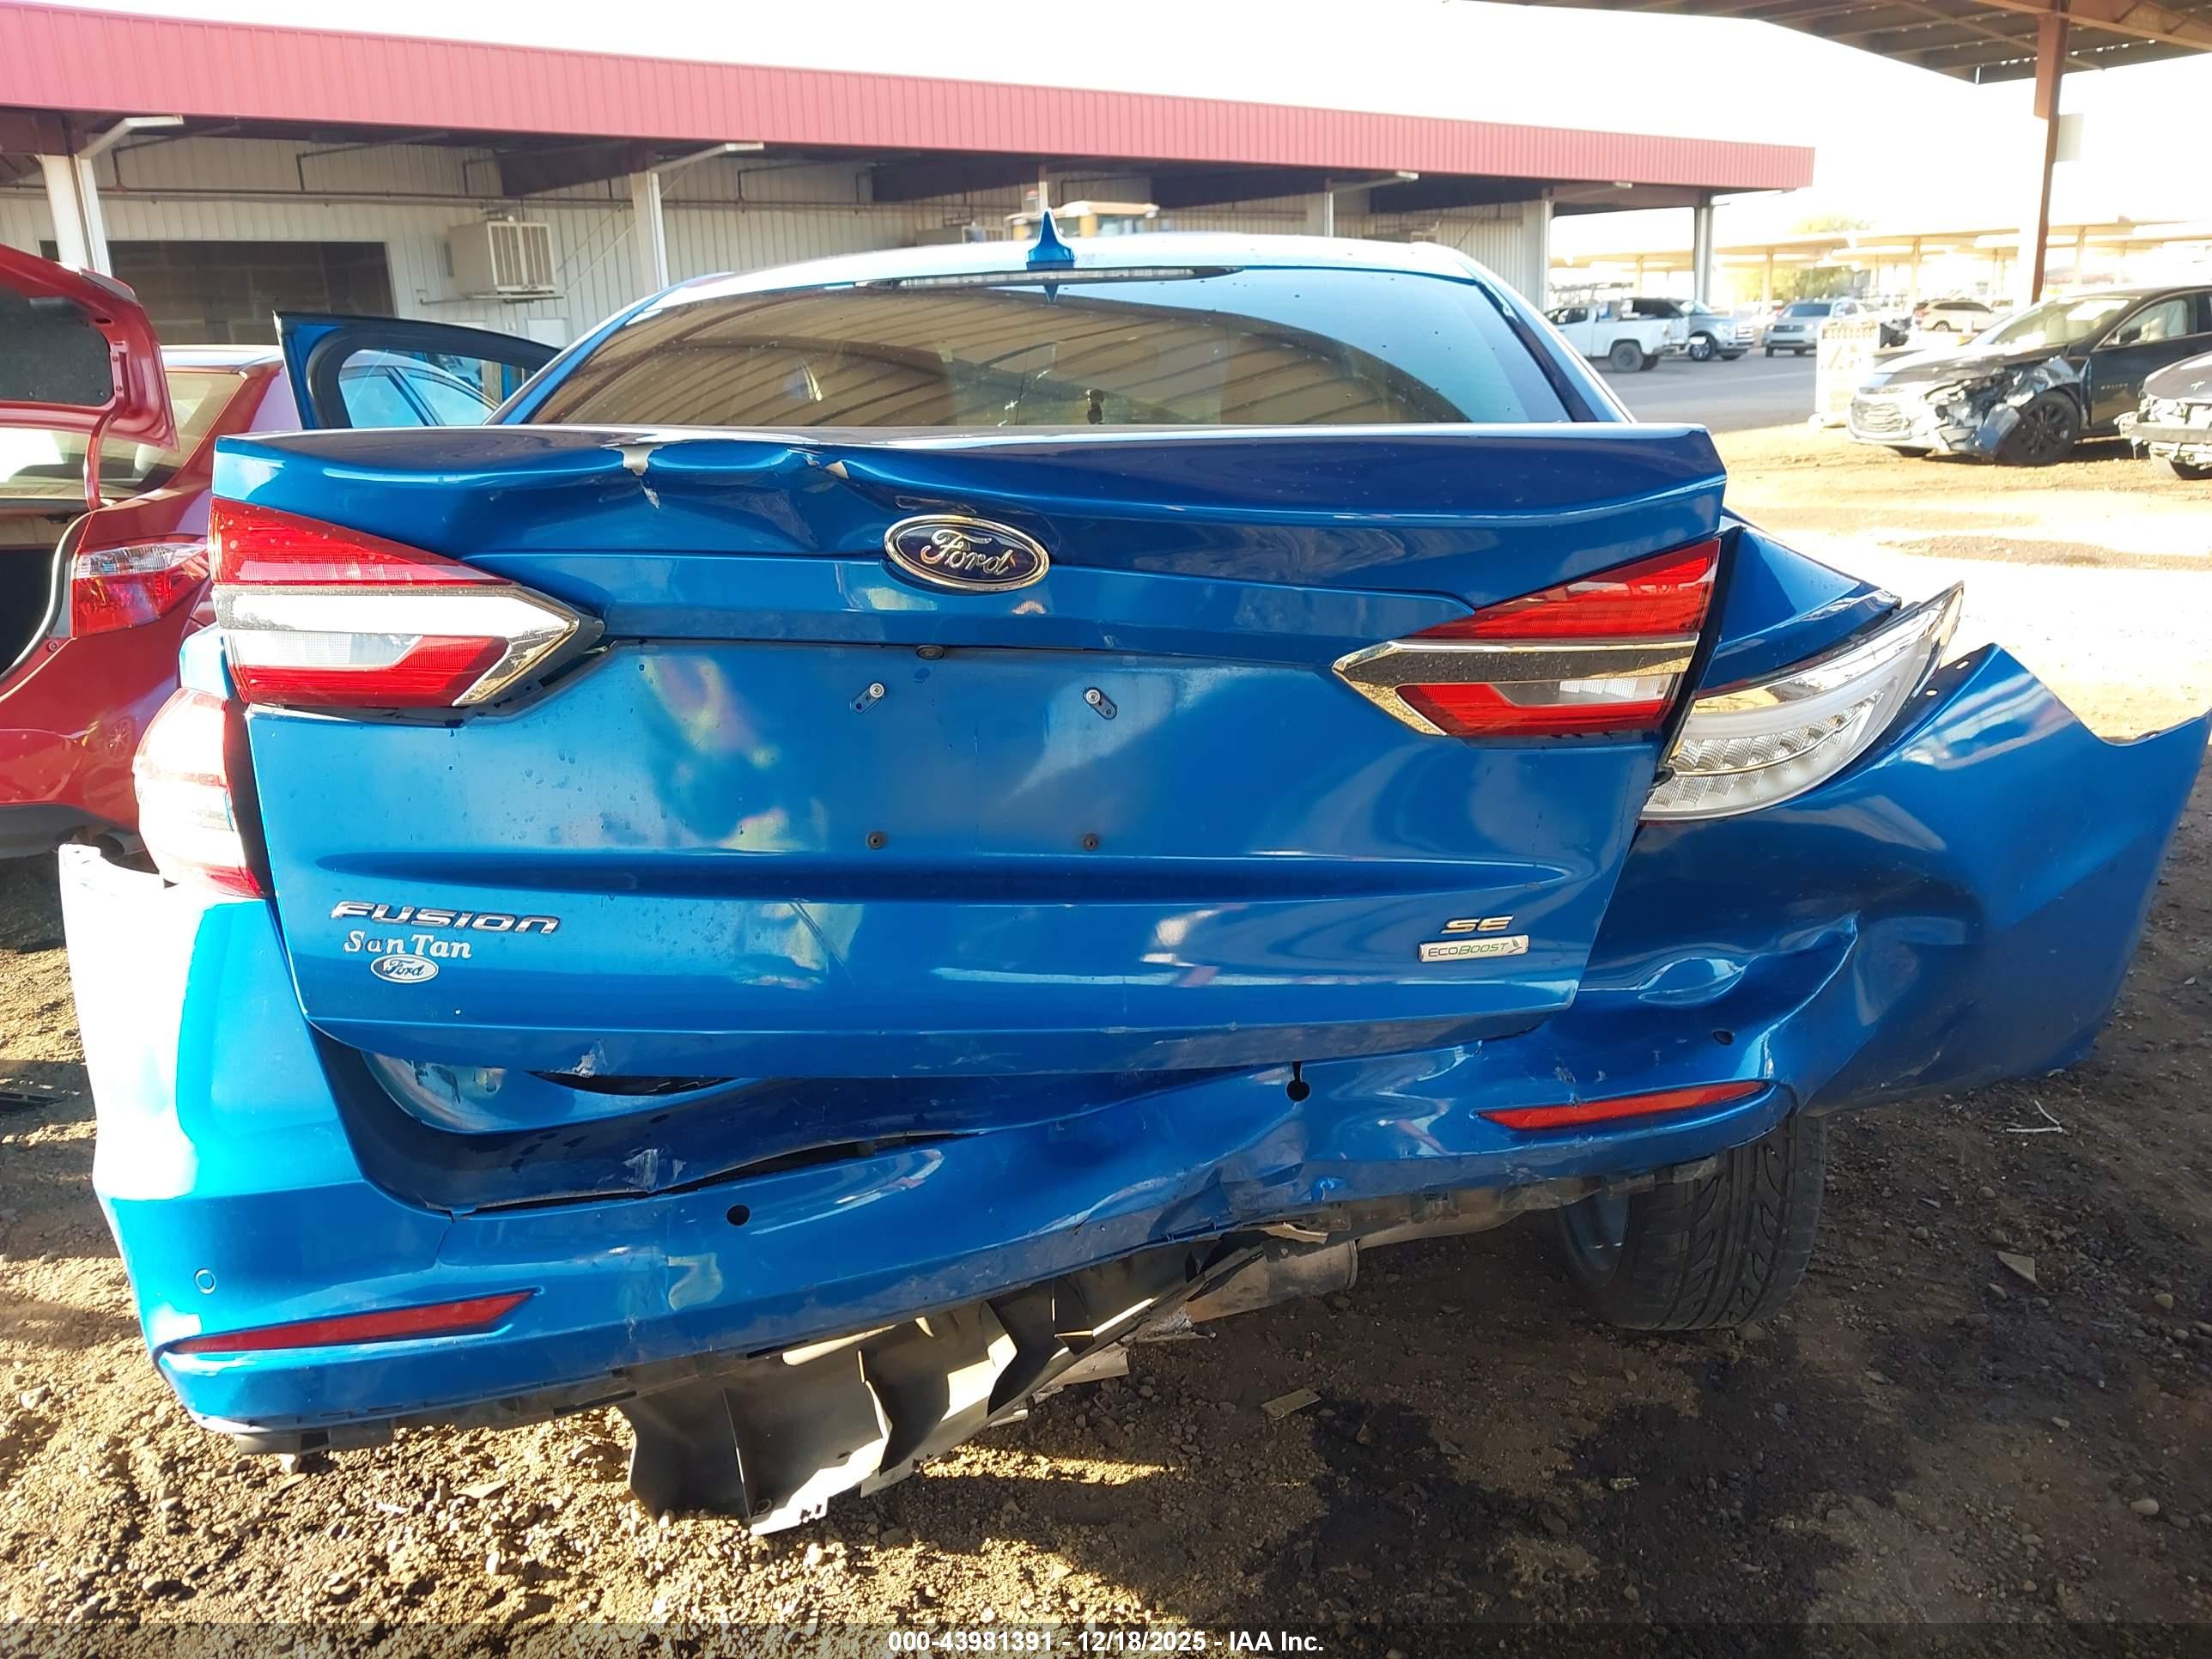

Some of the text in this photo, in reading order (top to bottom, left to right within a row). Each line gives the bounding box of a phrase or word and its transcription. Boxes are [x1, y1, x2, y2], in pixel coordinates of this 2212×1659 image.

[920, 528, 1017, 575] Ford
[330, 900, 561, 934] FUSION
[1440, 915, 1514, 934] SE
[343, 930, 472, 959] San Tan
[384, 958, 425, 976] Ford
